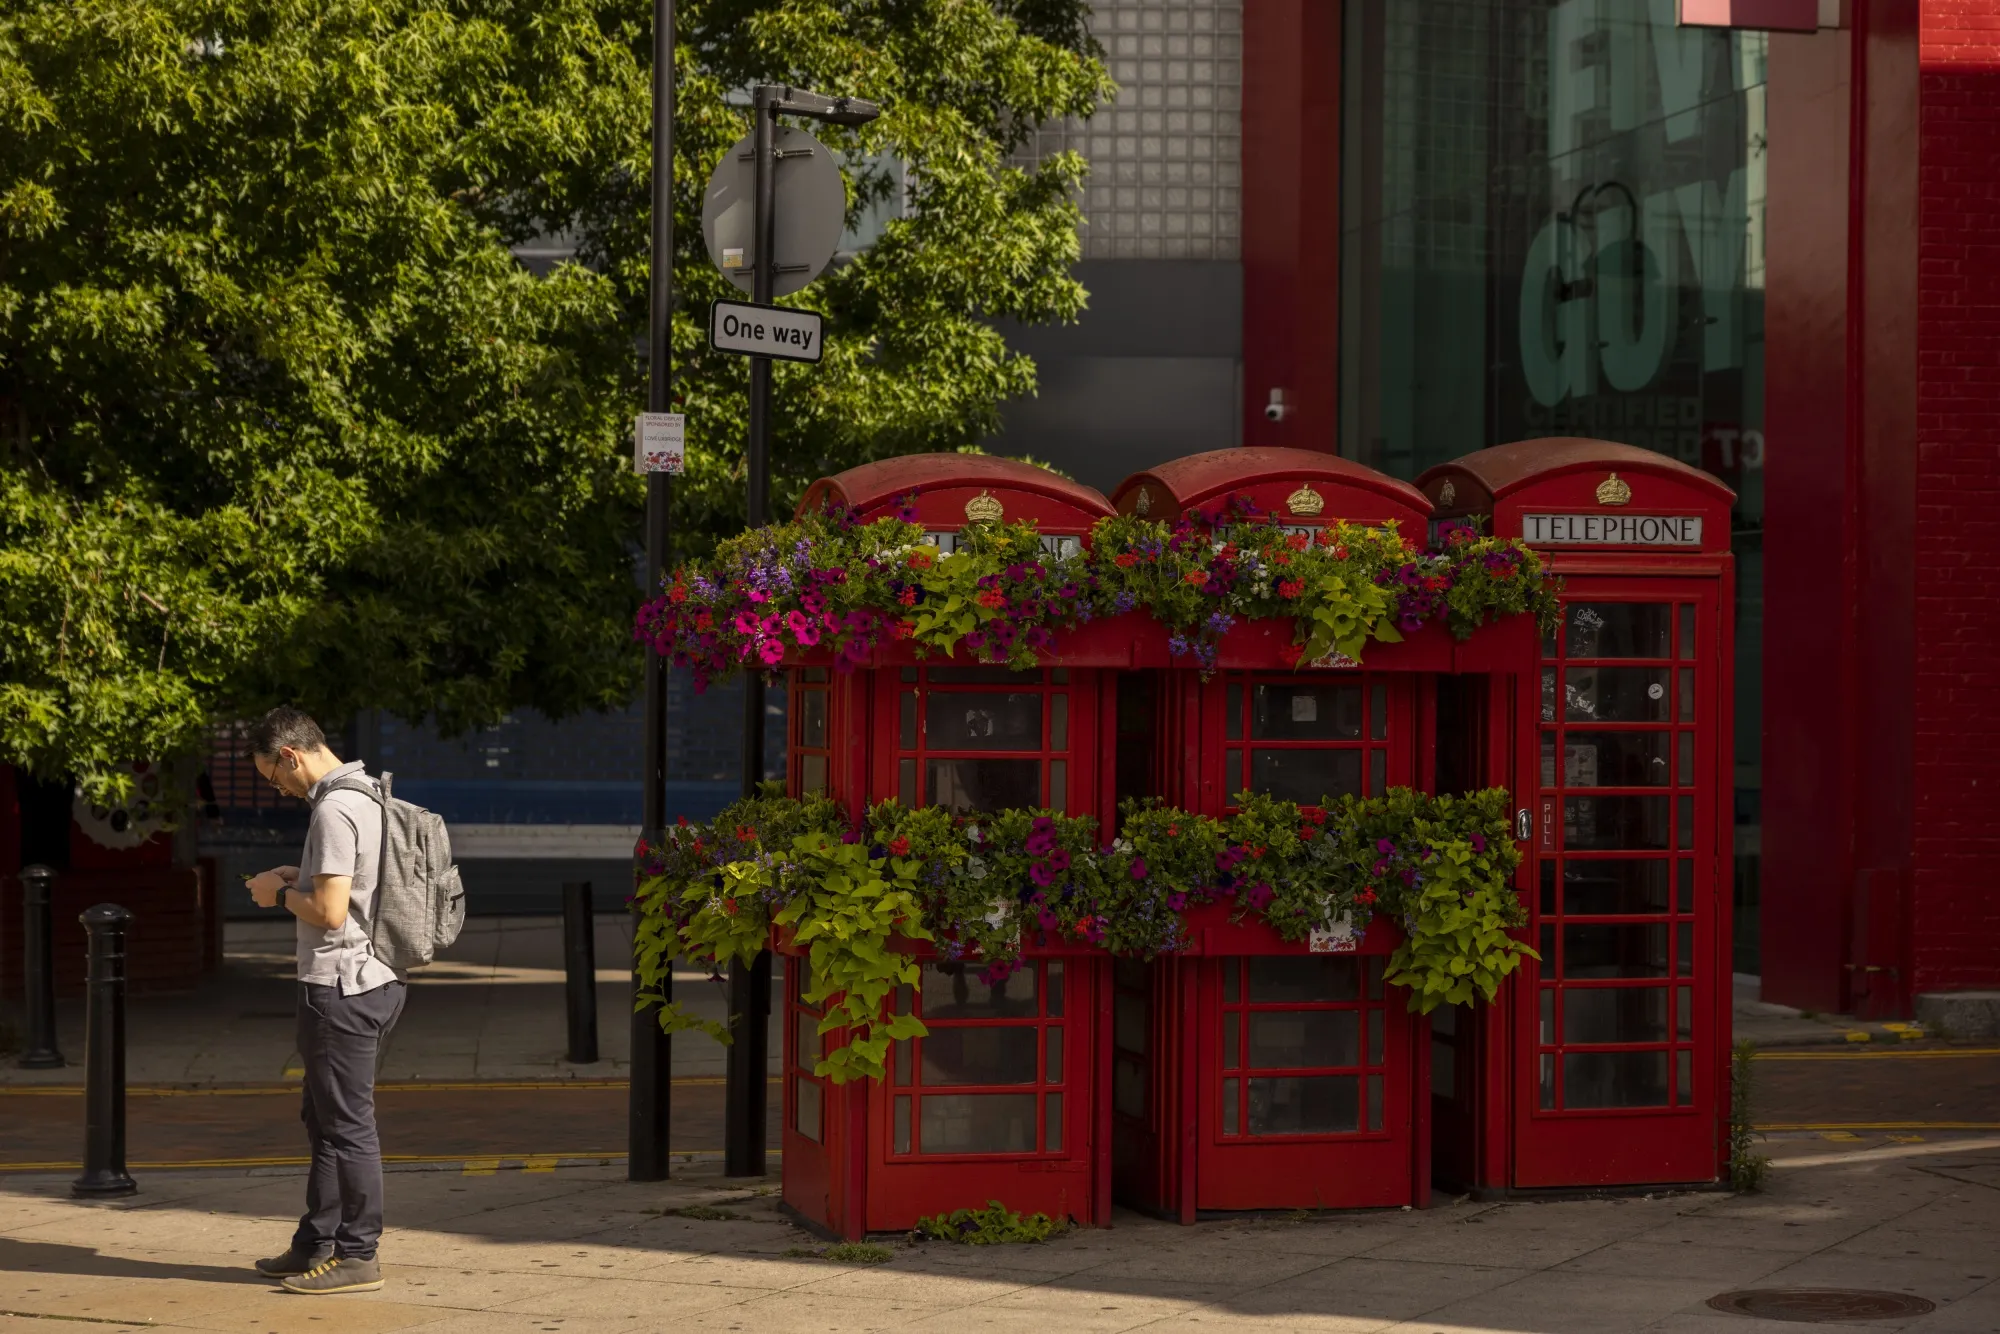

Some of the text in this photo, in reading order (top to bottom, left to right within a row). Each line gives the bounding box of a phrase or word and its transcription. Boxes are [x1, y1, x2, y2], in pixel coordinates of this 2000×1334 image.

[723, 315, 812, 350] One way
[1529, 516, 1695, 542] TELEPHONE
[1543, 803, 1551, 845] PULL
